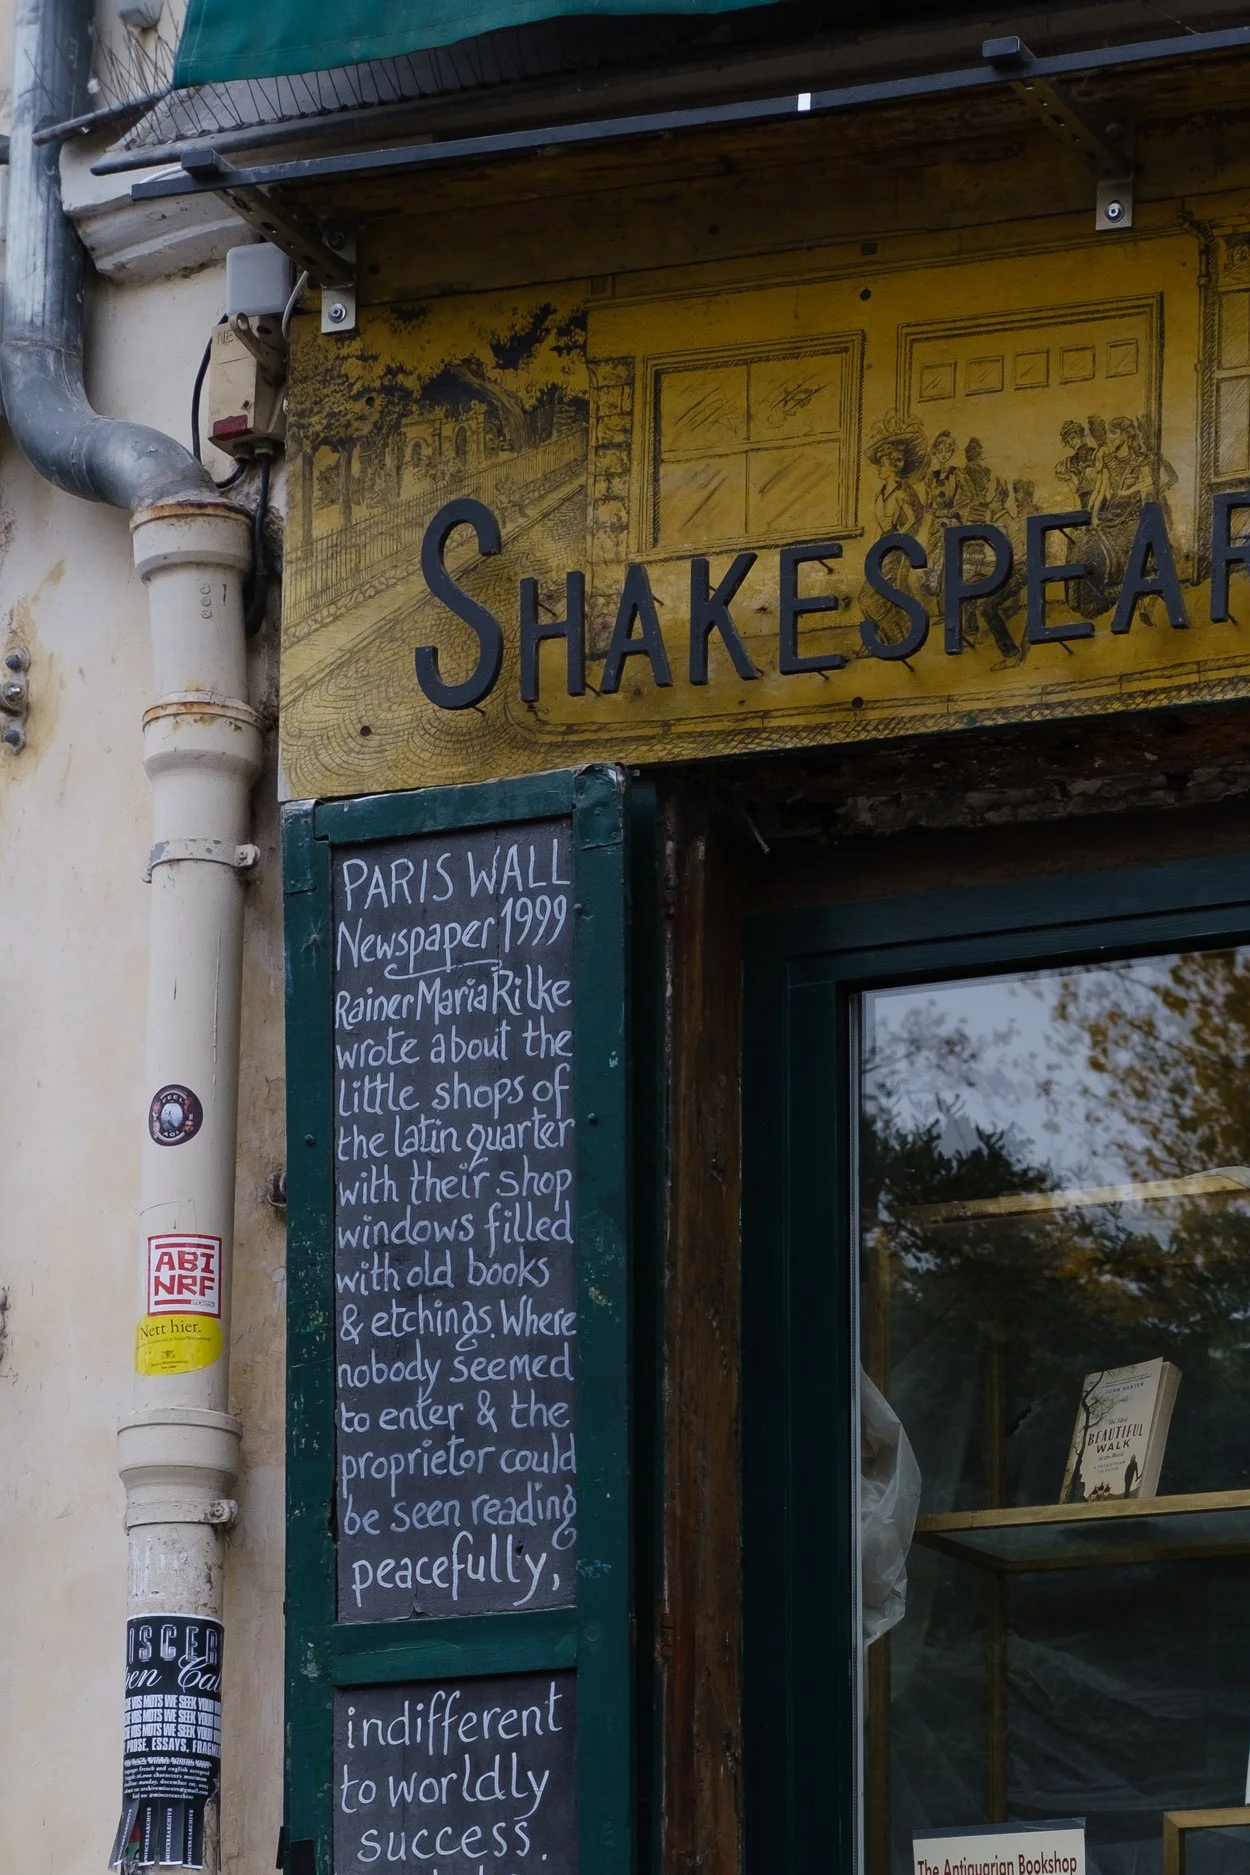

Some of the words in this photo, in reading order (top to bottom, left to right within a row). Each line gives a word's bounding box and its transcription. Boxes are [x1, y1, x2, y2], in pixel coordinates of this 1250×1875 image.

[342, 852, 454, 911] PARIS
[467, 838, 571, 899] WALL
[336, 916, 495, 974] Newspaper
[500, 895, 567, 952] 1999
[335, 986, 415, 1030] Rainer
[416, 978, 489, 1025] Maria
[491, 964, 573, 1016] Rilke
[336, 1027, 420, 1070] wrote
[430, 1020, 511, 1065] about
[523, 1016, 574, 1058] the
[338, 1071, 420, 1117] little
[432, 1071, 525, 1119] shops
[533, 1063, 570, 1120] of
[338, 1125, 388, 1161] the
[394, 1114, 462, 1157] latin
[466, 1107, 575, 1173] quarter
[338, 1164, 400, 1206] with
[411, 1159, 490, 1206] their
[496, 1155, 573, 1212] shop
[336, 1204, 474, 1249] windows
[484, 1200, 574, 1258] filled
[154, 1273, 215, 1297] NRF
[155, 1250, 215, 1275] ABI
[336, 1252, 399, 1296] with
[407, 1249, 454, 1289] old
[468, 1246, 550, 1288] books
[140, 1323, 166, 1338] Nett
[340, 1303, 365, 1344] &
[371, 1294, 496, 1351] etchings.
[499, 1295, 577, 1338] Where
[337, 1339, 441, 1398] nobody
[449, 1341, 575, 1384] seemed
[340, 1402, 370, 1433] to
[379, 1387, 464, 1431] enter
[476, 1389, 498, 1432] &
[510, 1389, 570, 1429] the
[1087, 1423, 1144, 1446] BEAUTIFUL
[341, 1435, 497, 1499] proprietor
[500, 1433, 577, 1475] could
[1096, 1439, 1131, 1453] WALK
[344, 1493, 381, 1536] be
[390, 1499, 461, 1533] seen
[472, 1481, 577, 1550] reading
[351, 1530, 560, 1608] peacefully,
[347, 1681, 563, 1756] indifferent
[340, 1764, 376, 1814] to
[388, 1752, 550, 1821] worldly
[357, 1820, 548, 1863] success.
